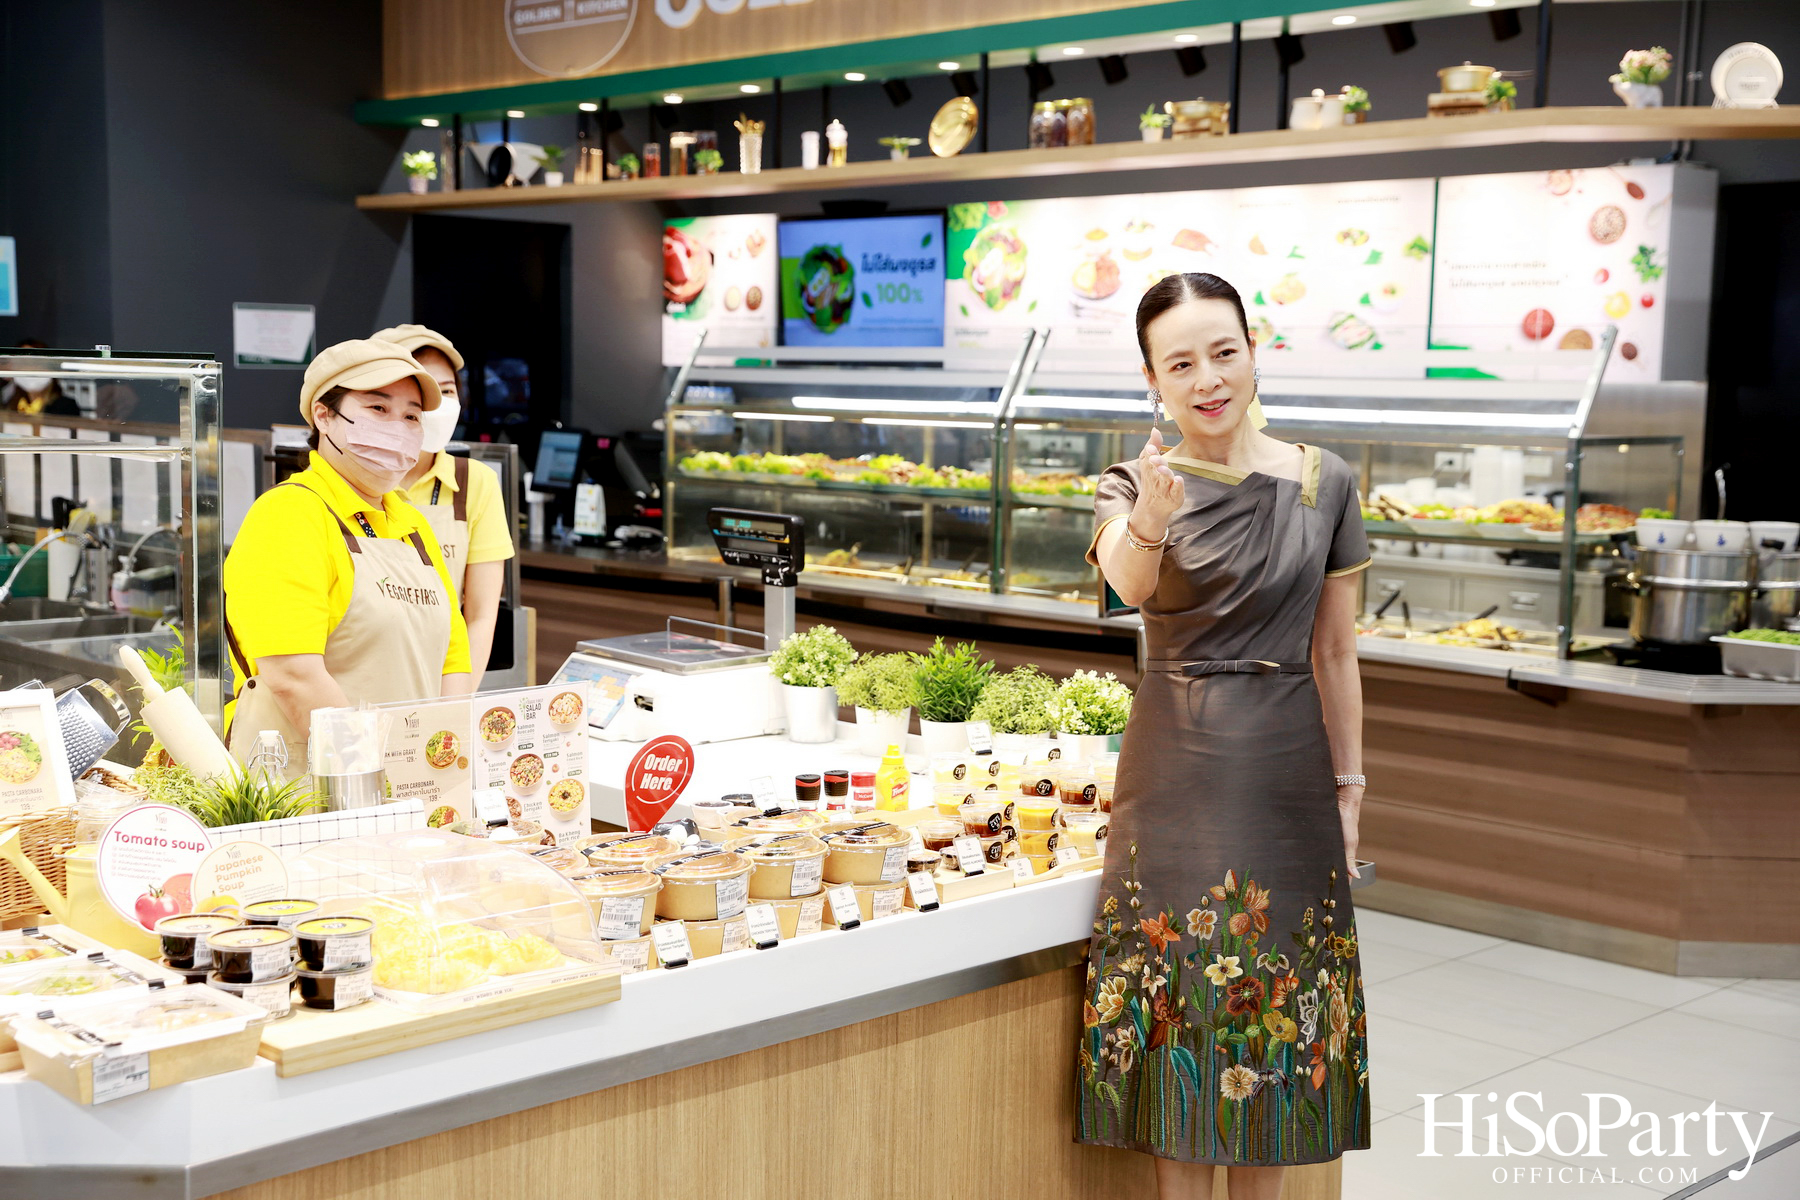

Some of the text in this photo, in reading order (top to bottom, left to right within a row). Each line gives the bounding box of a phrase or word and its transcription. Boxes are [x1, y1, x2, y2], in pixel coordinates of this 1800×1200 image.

[514, 7, 562, 26] GOLDEN
[525, 702, 542, 712] SALAD
[526, 711, 537, 721] BAR
[643, 753, 684, 773] Order
[640, 773, 673, 791] Here
[114, 830, 205, 853] Tomato soup
[214, 853, 264, 873] Japanese
[215, 865, 262, 883] Pumpkin
[218, 881, 245, 894] Soup
